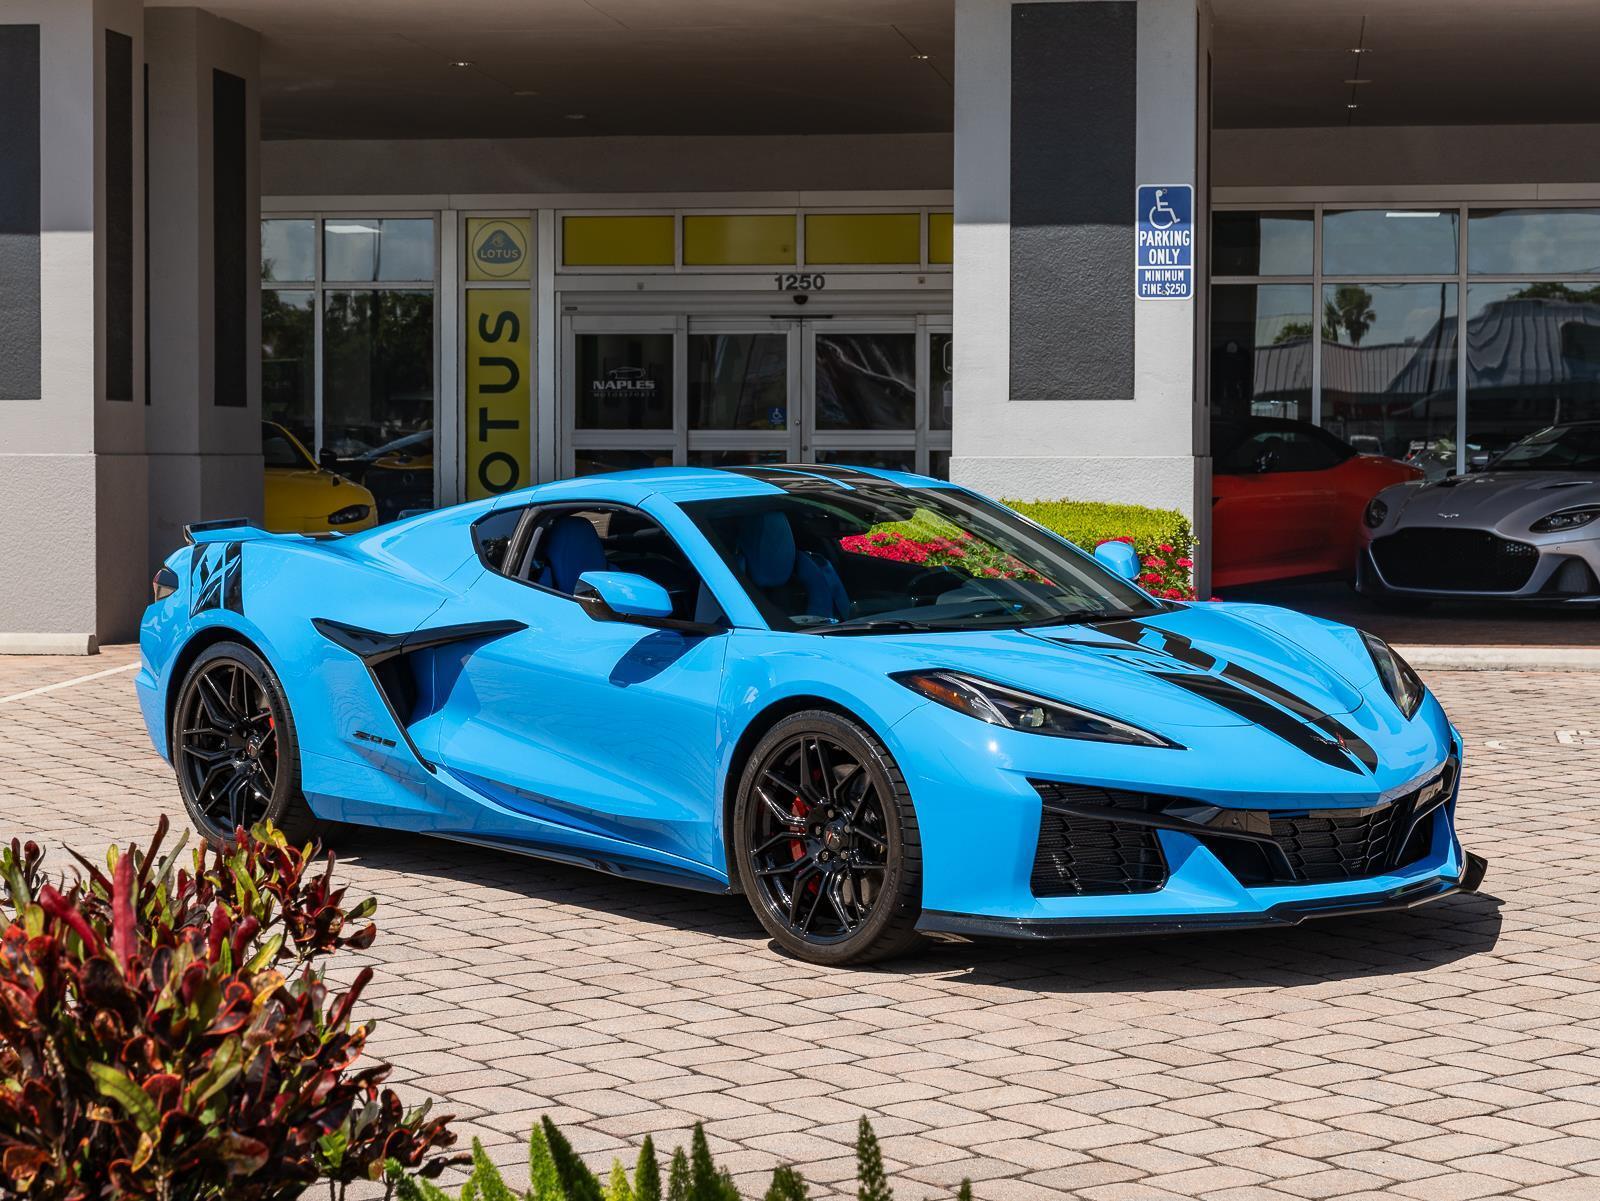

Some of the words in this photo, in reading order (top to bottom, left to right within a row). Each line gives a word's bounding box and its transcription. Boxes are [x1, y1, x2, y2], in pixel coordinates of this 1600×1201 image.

[1140, 230, 1190, 246] PARKING
[480, 249, 519, 258] LOTUS
[1149, 249, 1180, 265] ONLY
[774, 274, 826, 291] 1250
[1145, 270, 1184, 281] MINIMUM
[1165, 283, 1187, 295] $250
[593, 380, 656, 390] NAPLES
[478, 310, 520, 494] OTUS
